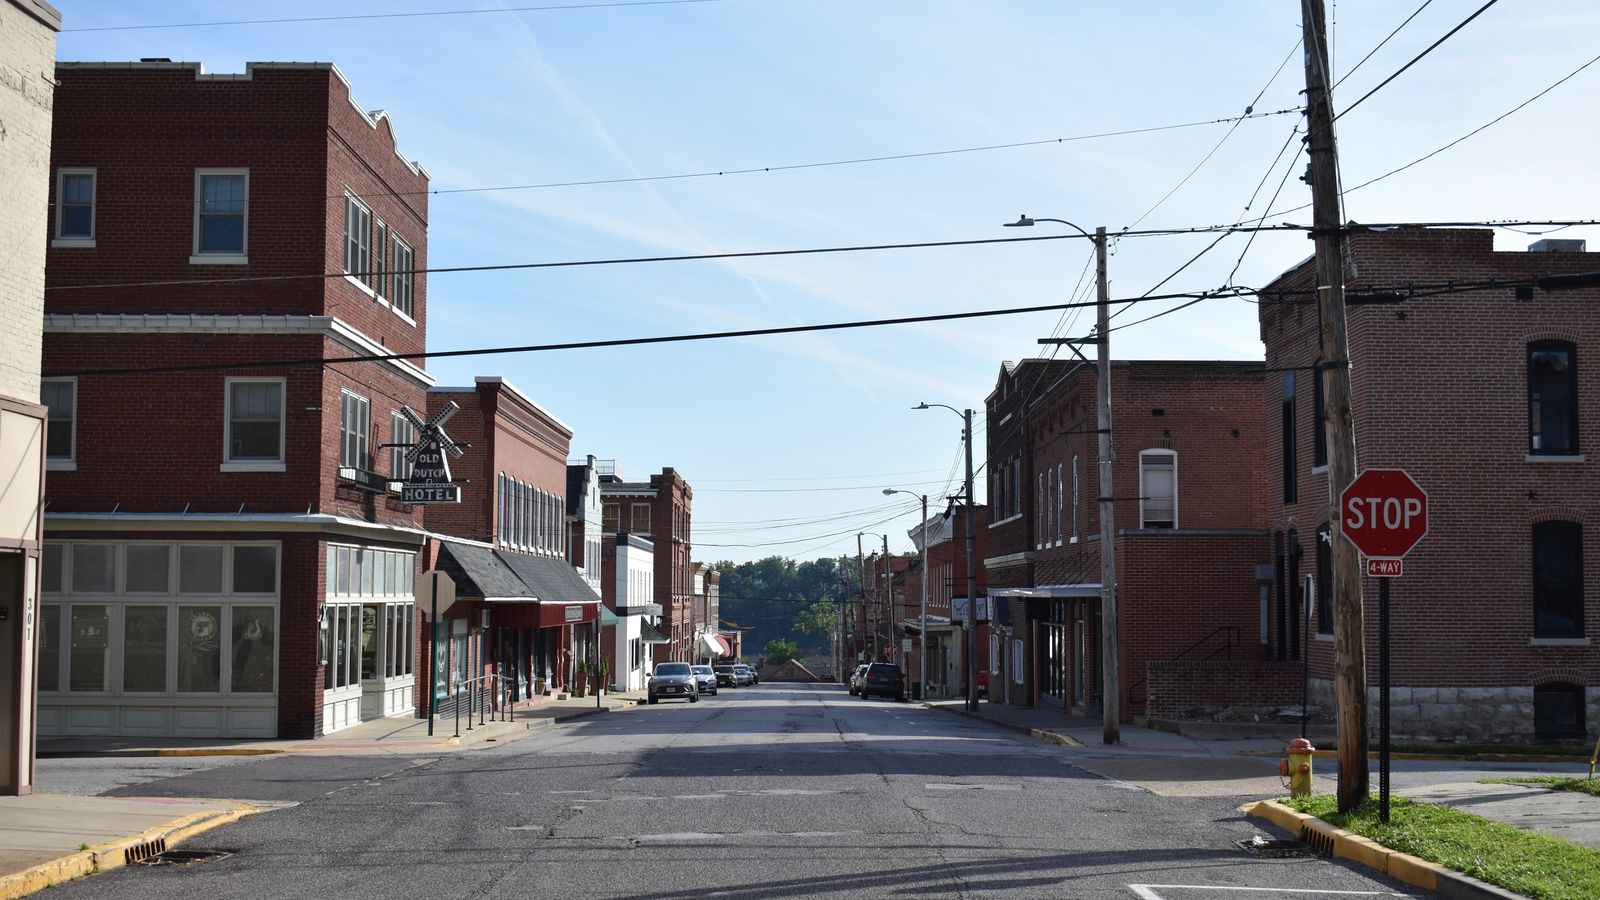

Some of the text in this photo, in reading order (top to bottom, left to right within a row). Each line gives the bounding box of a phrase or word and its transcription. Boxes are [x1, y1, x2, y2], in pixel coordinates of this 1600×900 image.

[419, 454, 440, 463] OLD
[414, 468, 445, 478] DUTCH
[404, 489, 454, 501] HOTEL
[1346, 497, 1422, 530] STOP
[1369, 562, 1400, 573] 4-WAY
